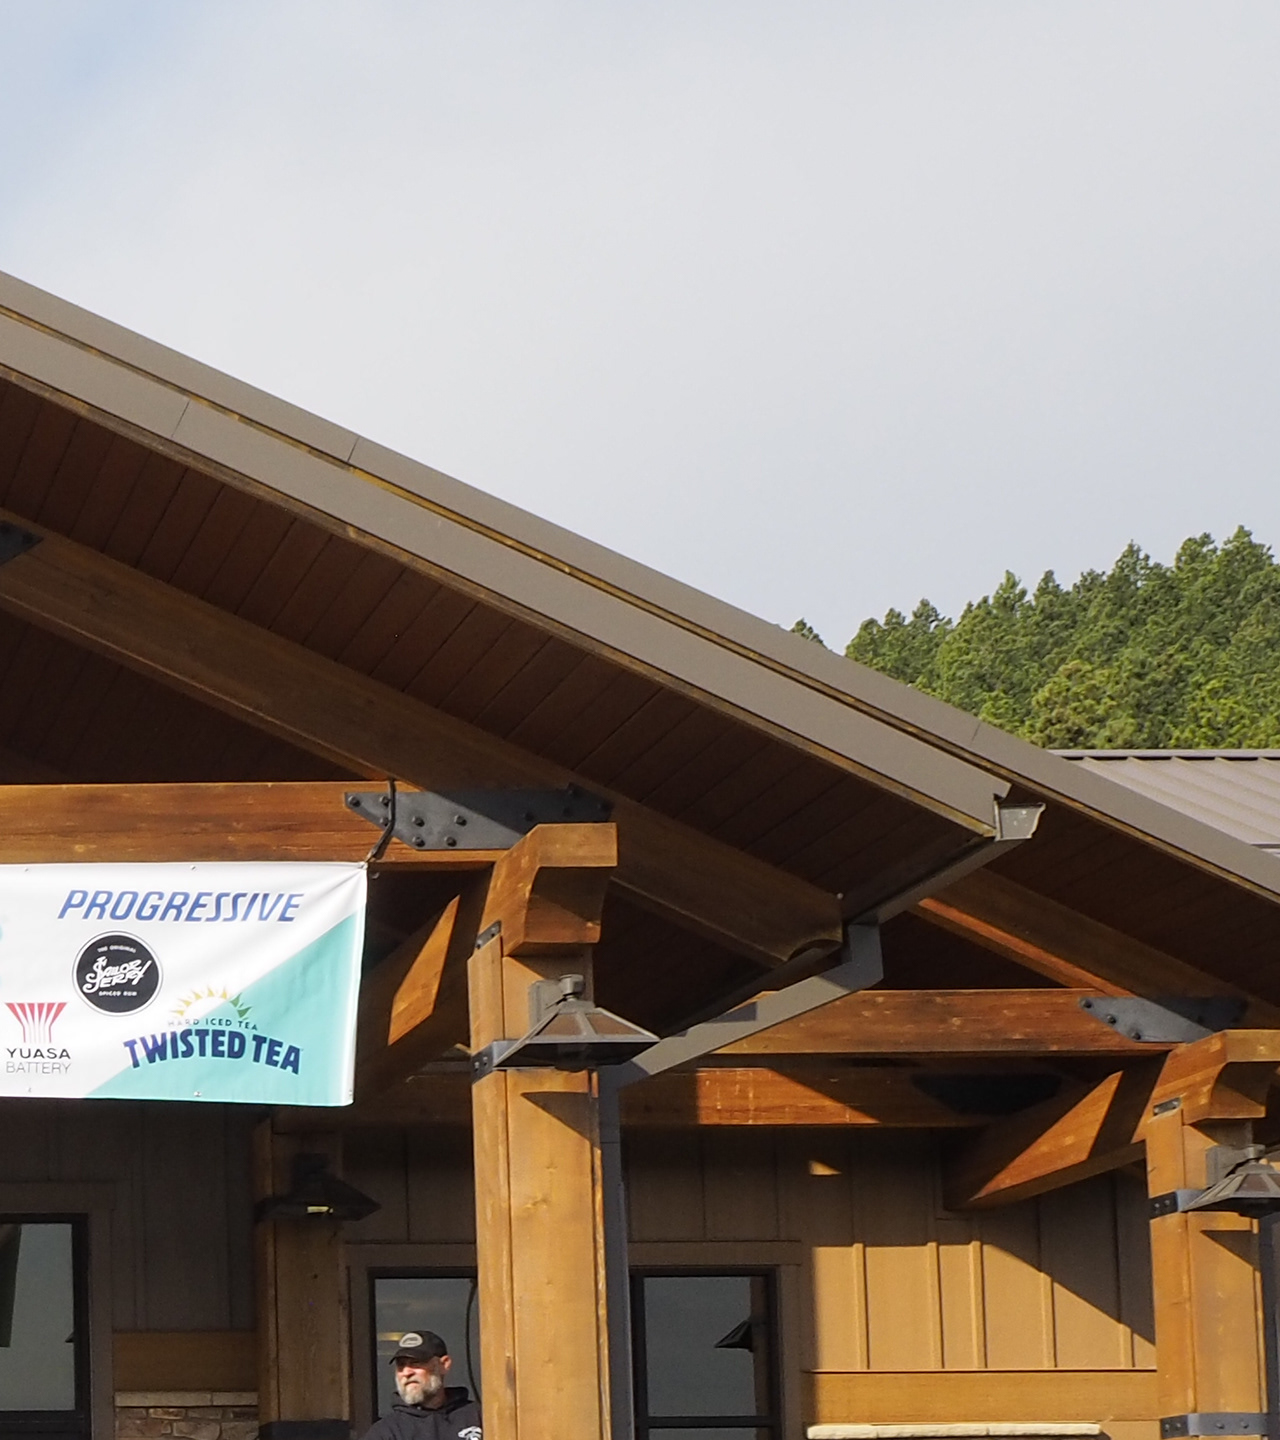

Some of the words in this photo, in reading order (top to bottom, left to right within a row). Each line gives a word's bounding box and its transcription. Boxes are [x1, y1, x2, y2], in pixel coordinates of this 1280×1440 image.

[58, 889, 305, 922] PROGRESSIVE
[205, 1017, 232, 1027] ICED
[237, 1020, 258, 1031] TEA
[5, 1047, 71, 1060] YUASA
[123, 1028, 240, 1069] TWISTED
[250, 1033, 301, 1074] TEA
[5, 1061, 71, 1075] BATTERY
